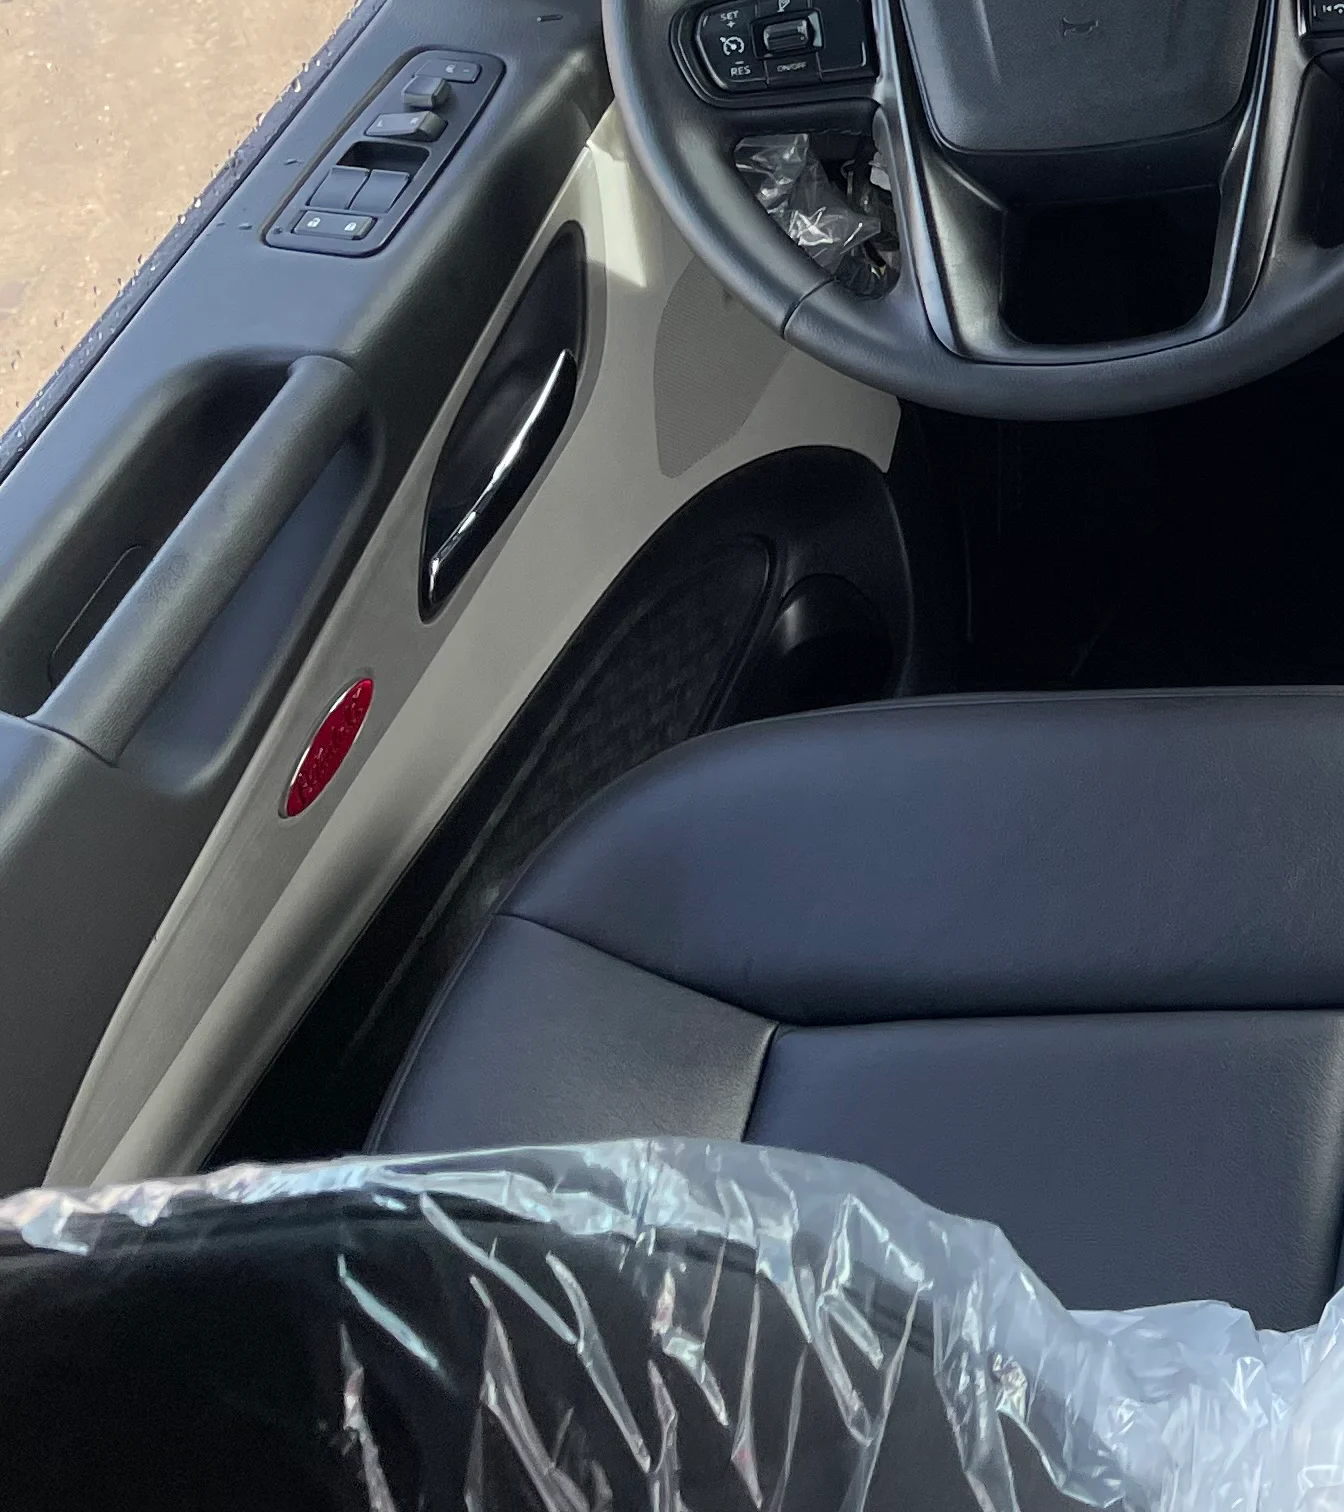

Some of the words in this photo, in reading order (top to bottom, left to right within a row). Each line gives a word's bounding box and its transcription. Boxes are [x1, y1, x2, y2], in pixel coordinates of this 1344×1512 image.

[720, 10, 739, 22] SET
[730, 64, 751, 77] RES
[776, 61, 807, 73] ON/OFF
